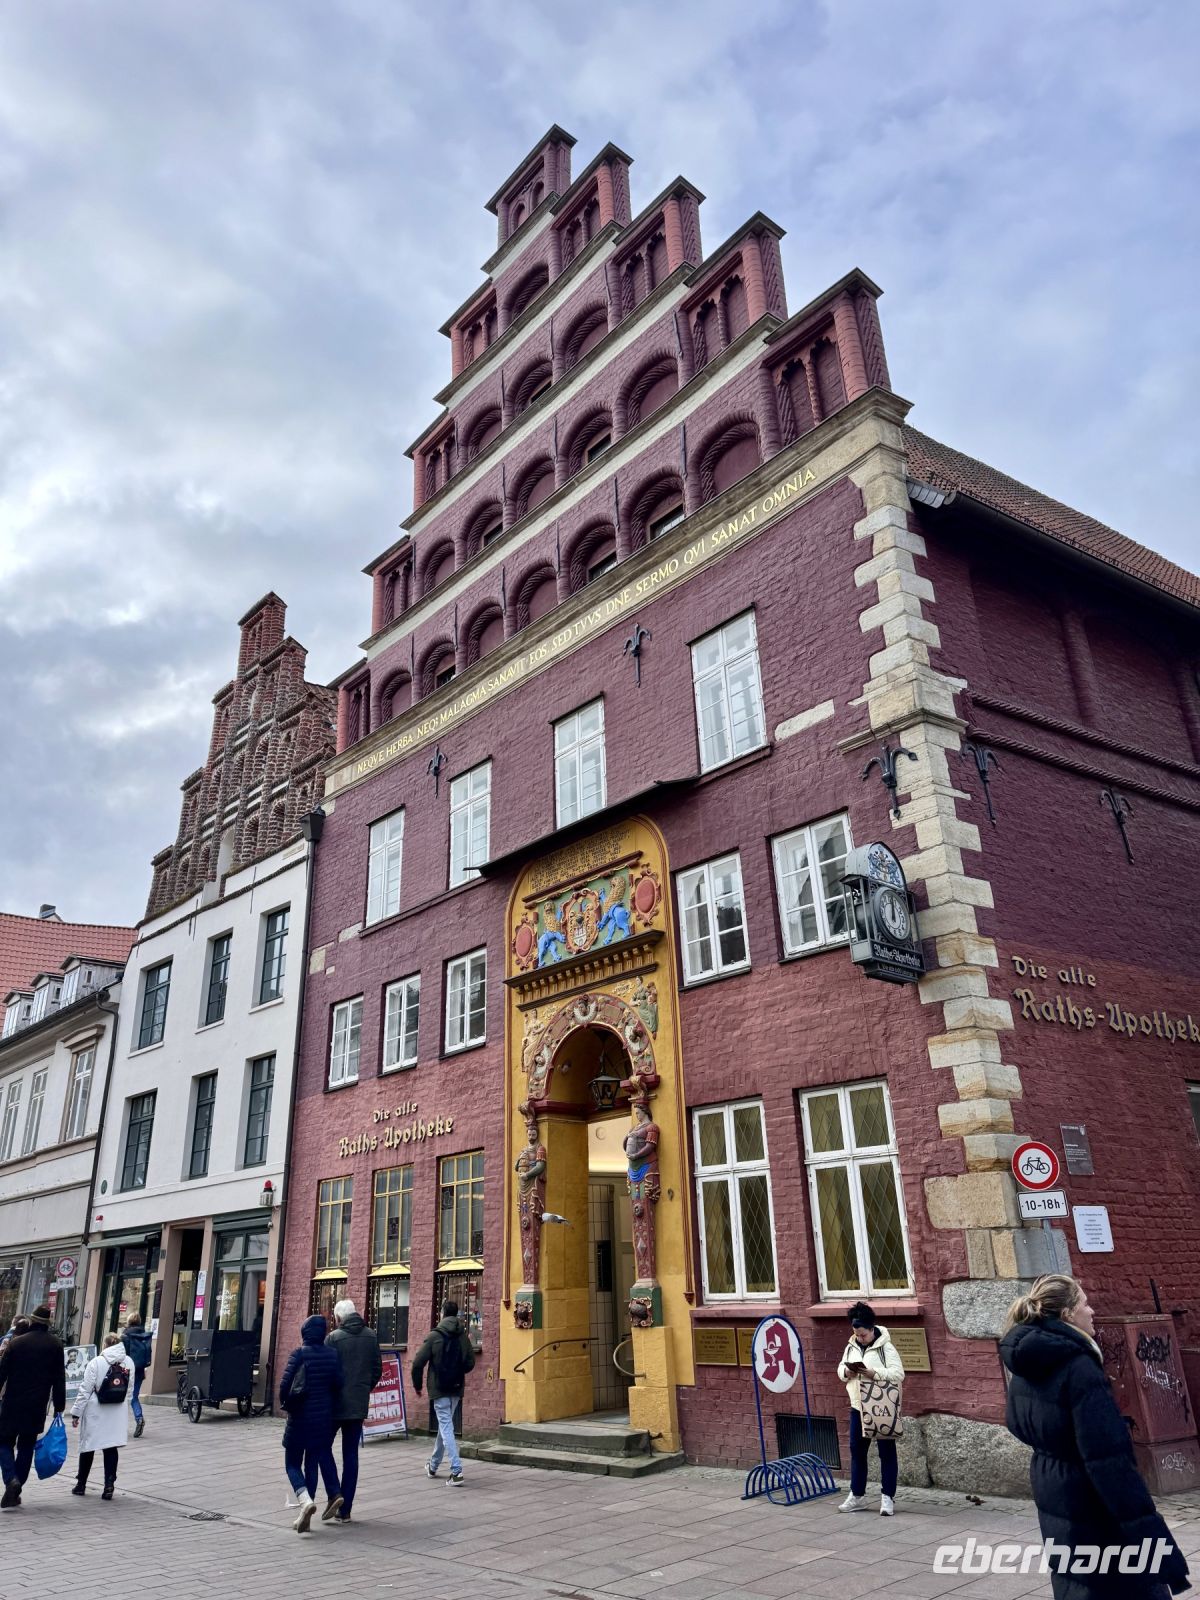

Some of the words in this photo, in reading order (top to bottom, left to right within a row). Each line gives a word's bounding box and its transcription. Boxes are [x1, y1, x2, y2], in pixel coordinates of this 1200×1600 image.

[357, 750, 384, 774] NEQVE
[386, 735, 413, 757] HERBA
[440, 688, 486, 725] MALAGMA
[552, 629, 572, 651] SED
[574, 611, 601, 636] TVVS
[635, 559, 679, 596] SERMO
[684, 537, 705, 565] QVI
[711, 506, 757, 548] SANAT
[762, 468, 816, 512] OMNIA
[1012, 955, 1048, 979] Die
[1057, 966, 1097, 987] alte
[373, 1108, 390, 1123] Die
